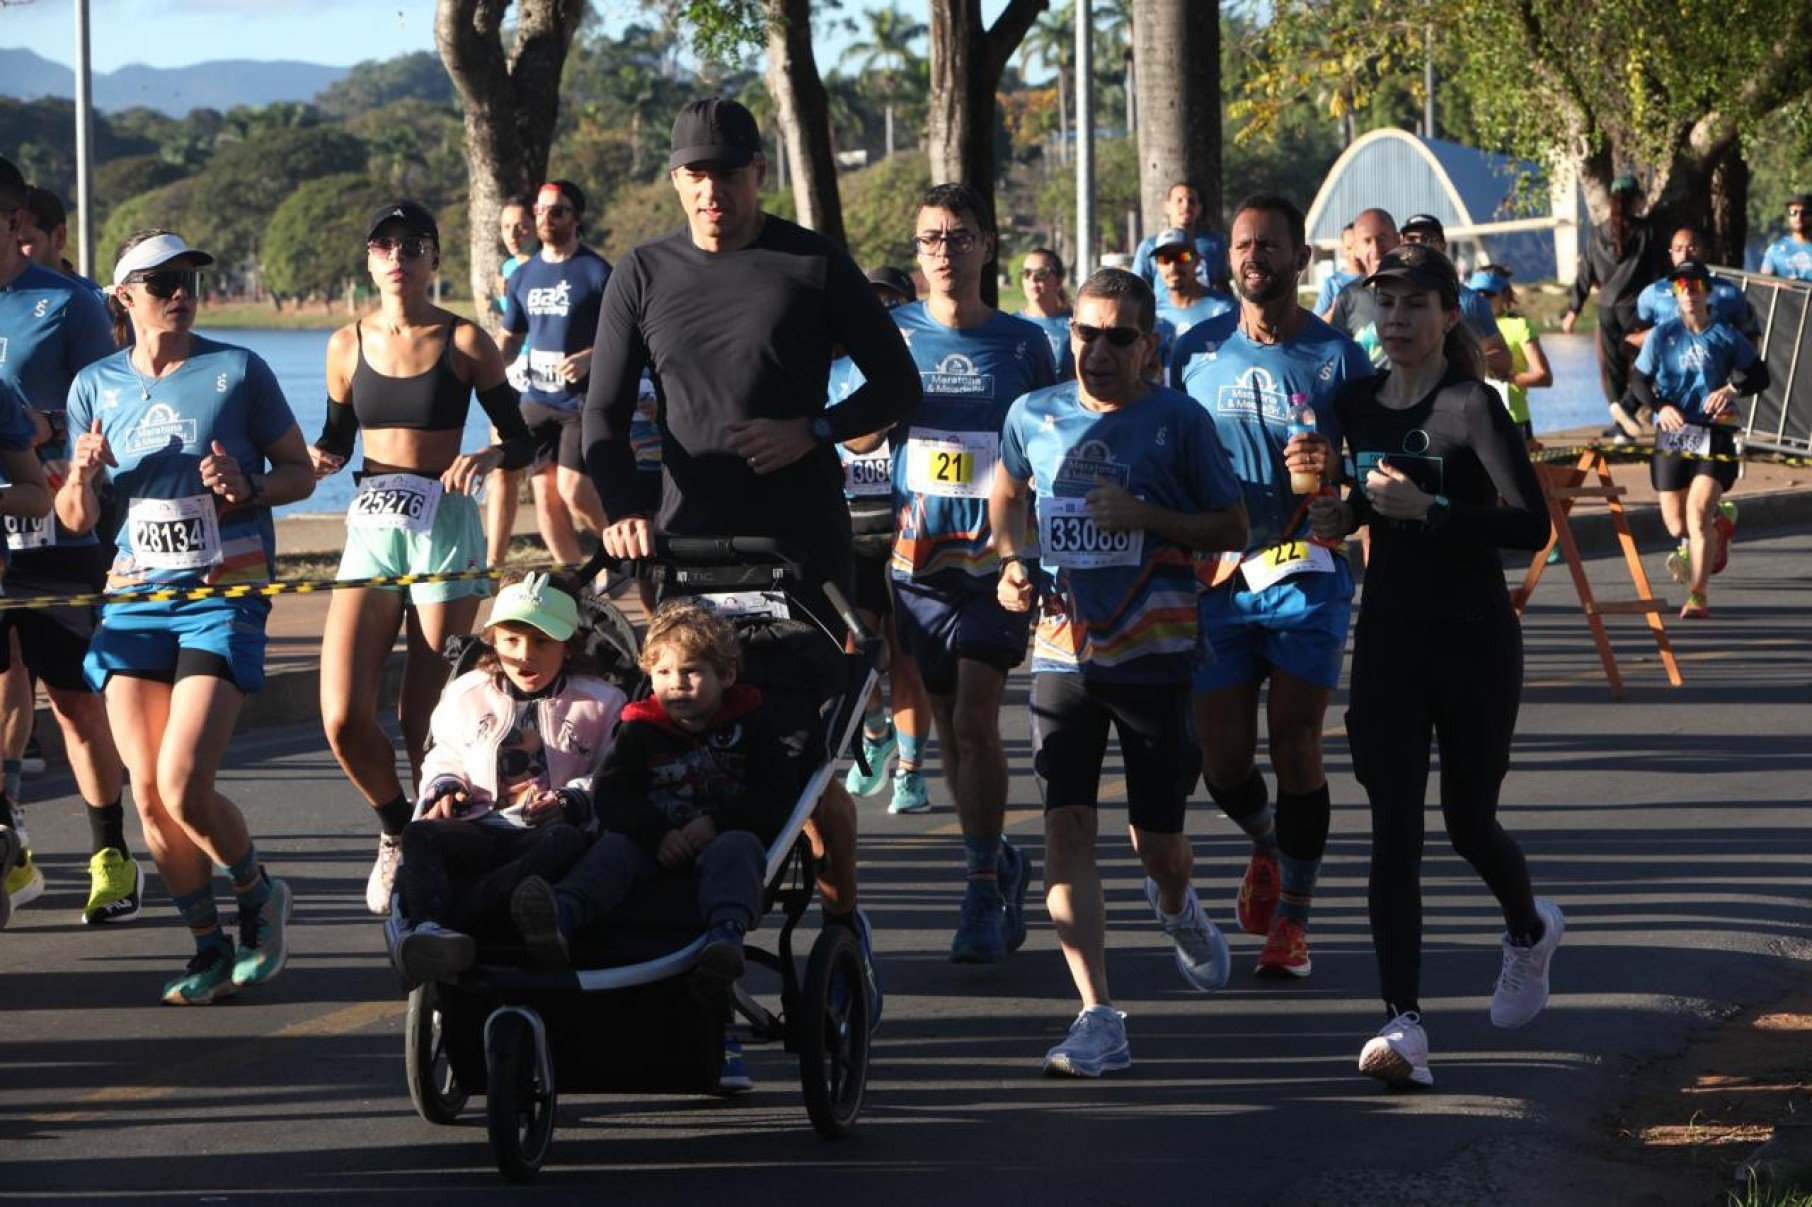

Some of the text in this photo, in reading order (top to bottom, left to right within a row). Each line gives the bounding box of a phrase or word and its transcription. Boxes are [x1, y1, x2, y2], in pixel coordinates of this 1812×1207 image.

[936, 452, 962, 482] 21
[359, 490, 423, 518] 25276
[137, 519, 205, 553] 28134
[1268, 541, 1301, 566] 22
